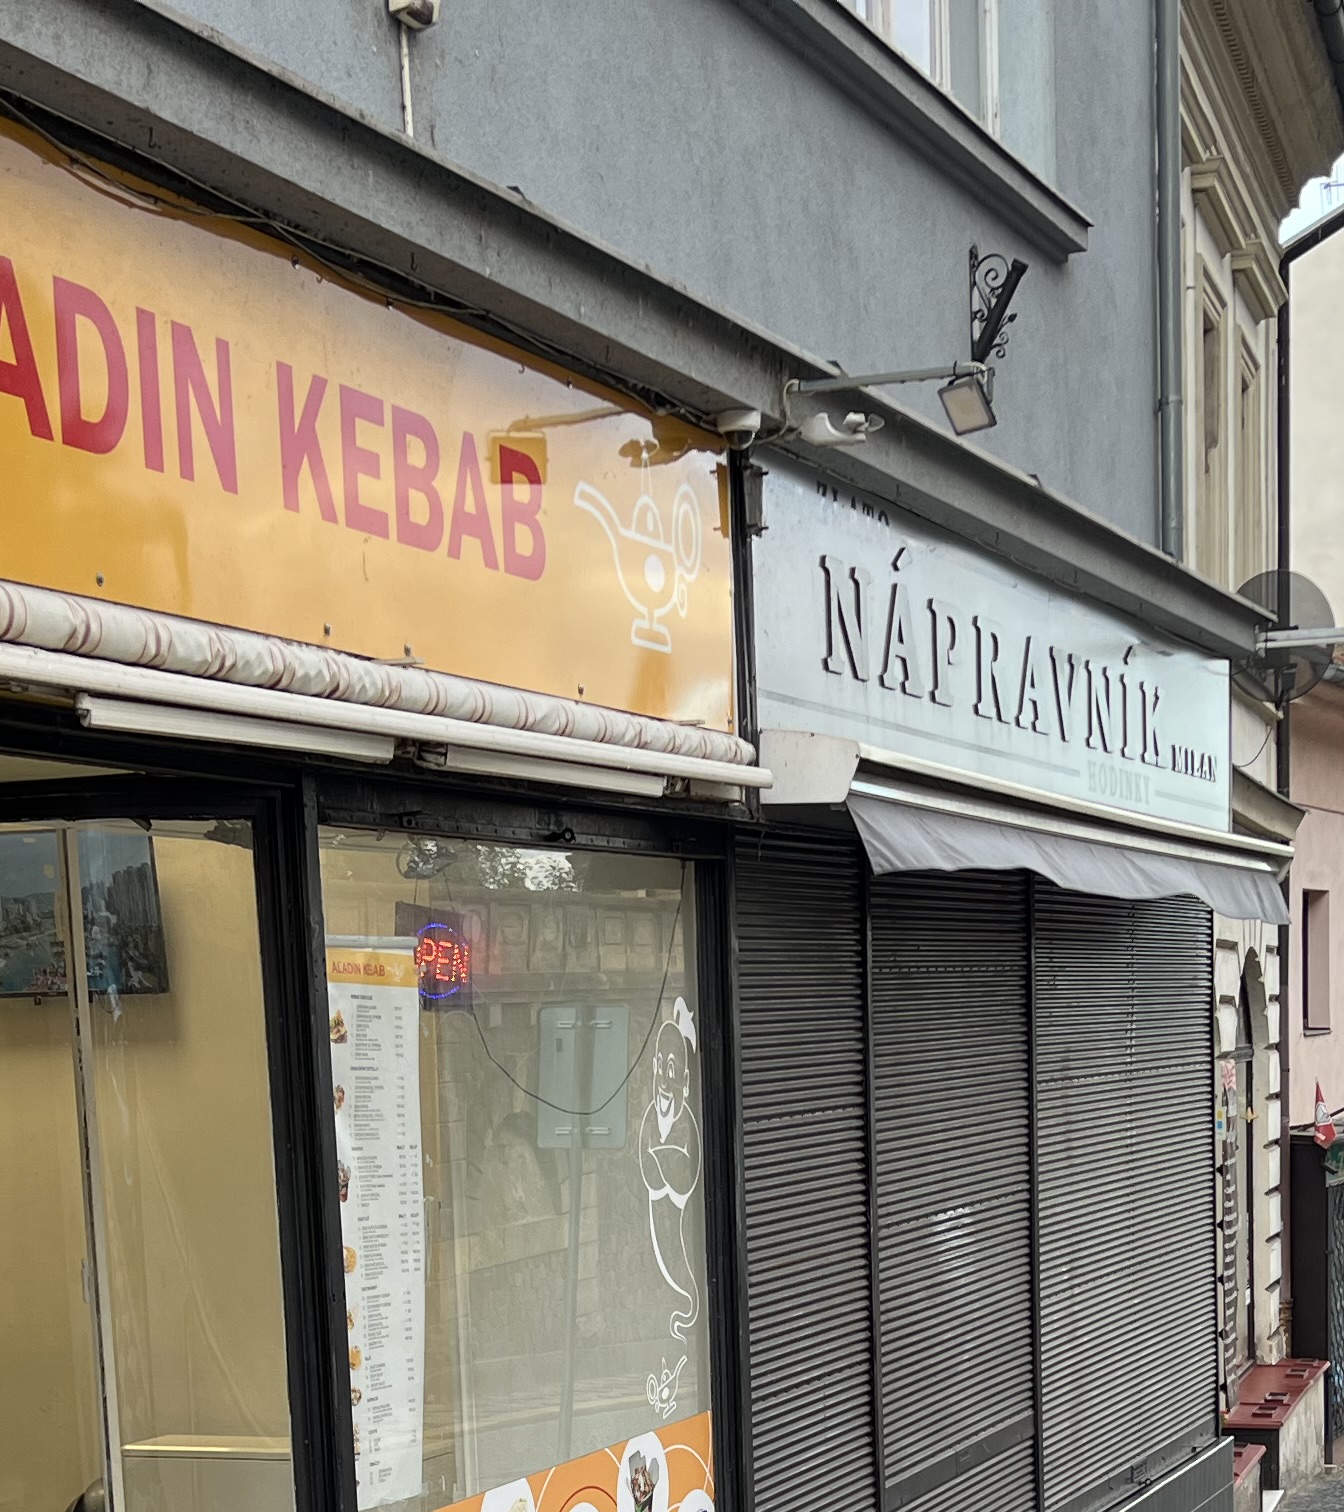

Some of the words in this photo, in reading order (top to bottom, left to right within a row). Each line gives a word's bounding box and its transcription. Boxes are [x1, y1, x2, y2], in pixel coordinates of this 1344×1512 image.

[275, 359, 546, 582] KEBAB
[818, 546, 1169, 769] NÁPRAVNÍK
[1087, 759, 1151, 807] HODINKY
[1171, 744, 1217, 783] MILAN
[415, 937, 469, 983] PEN
